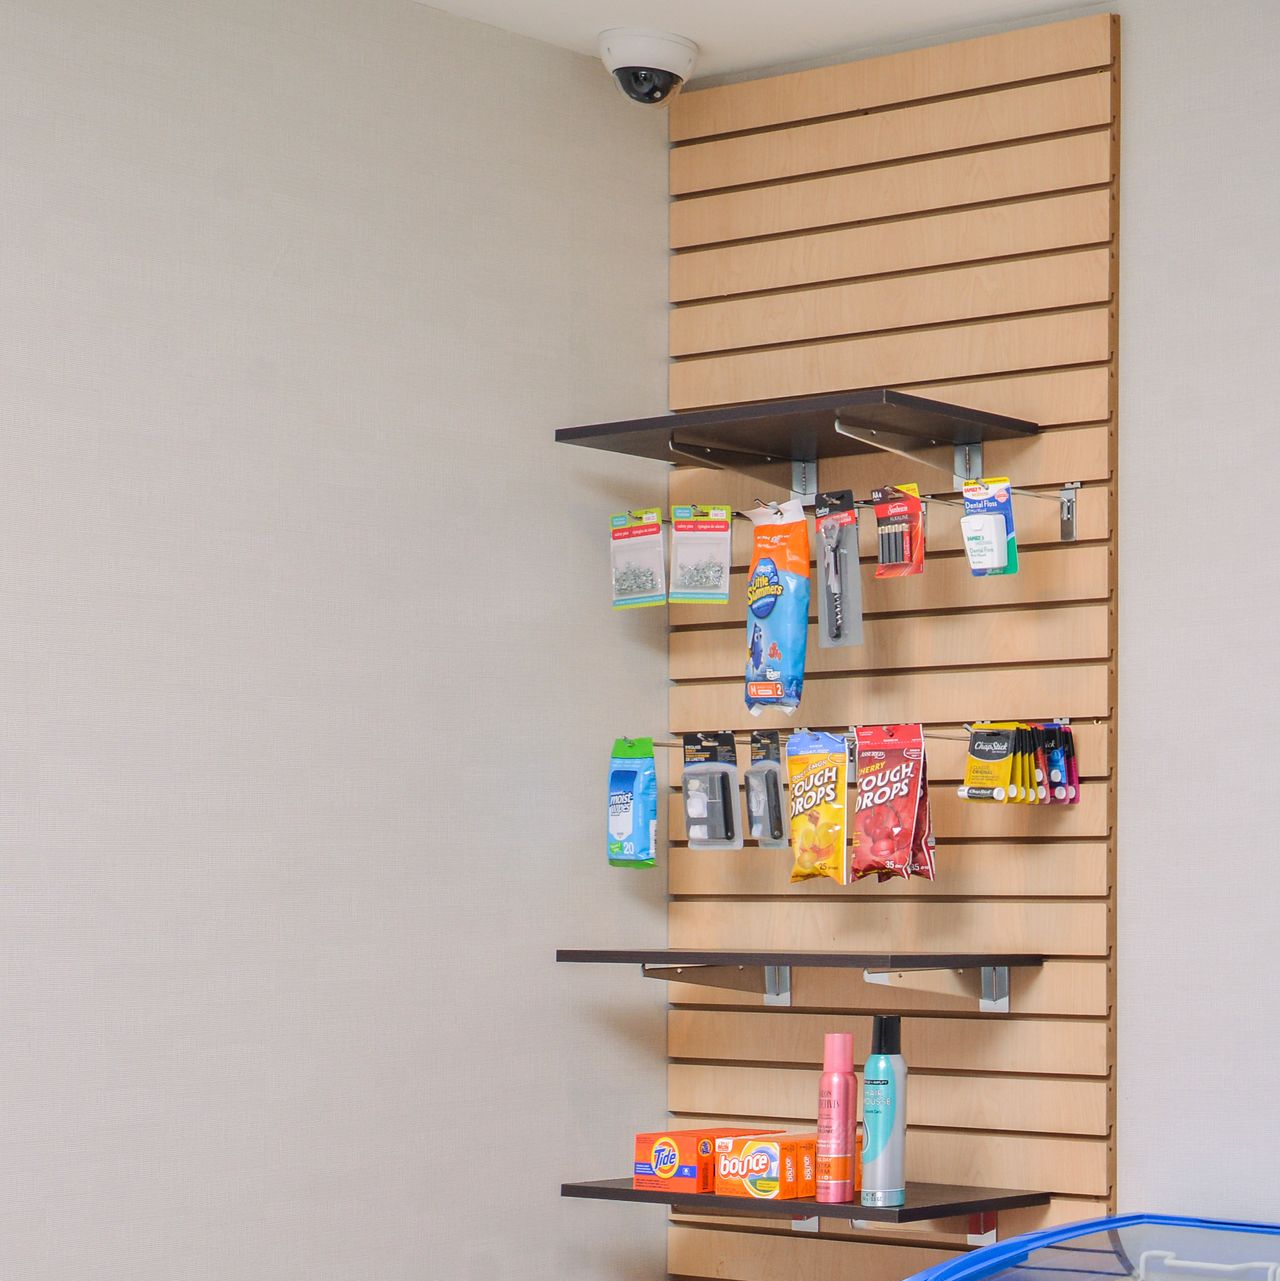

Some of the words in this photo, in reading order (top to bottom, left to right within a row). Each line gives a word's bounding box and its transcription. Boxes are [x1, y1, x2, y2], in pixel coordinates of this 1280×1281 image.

[965, 501, 983, 509] Dental
[974, 740, 1008, 751] ChapStick
[610, 792, 633, 803] moist
[623, 842, 634, 854] 20
[654, 1148, 676, 1169] Tide
[720, 1154, 768, 1177] bounce
